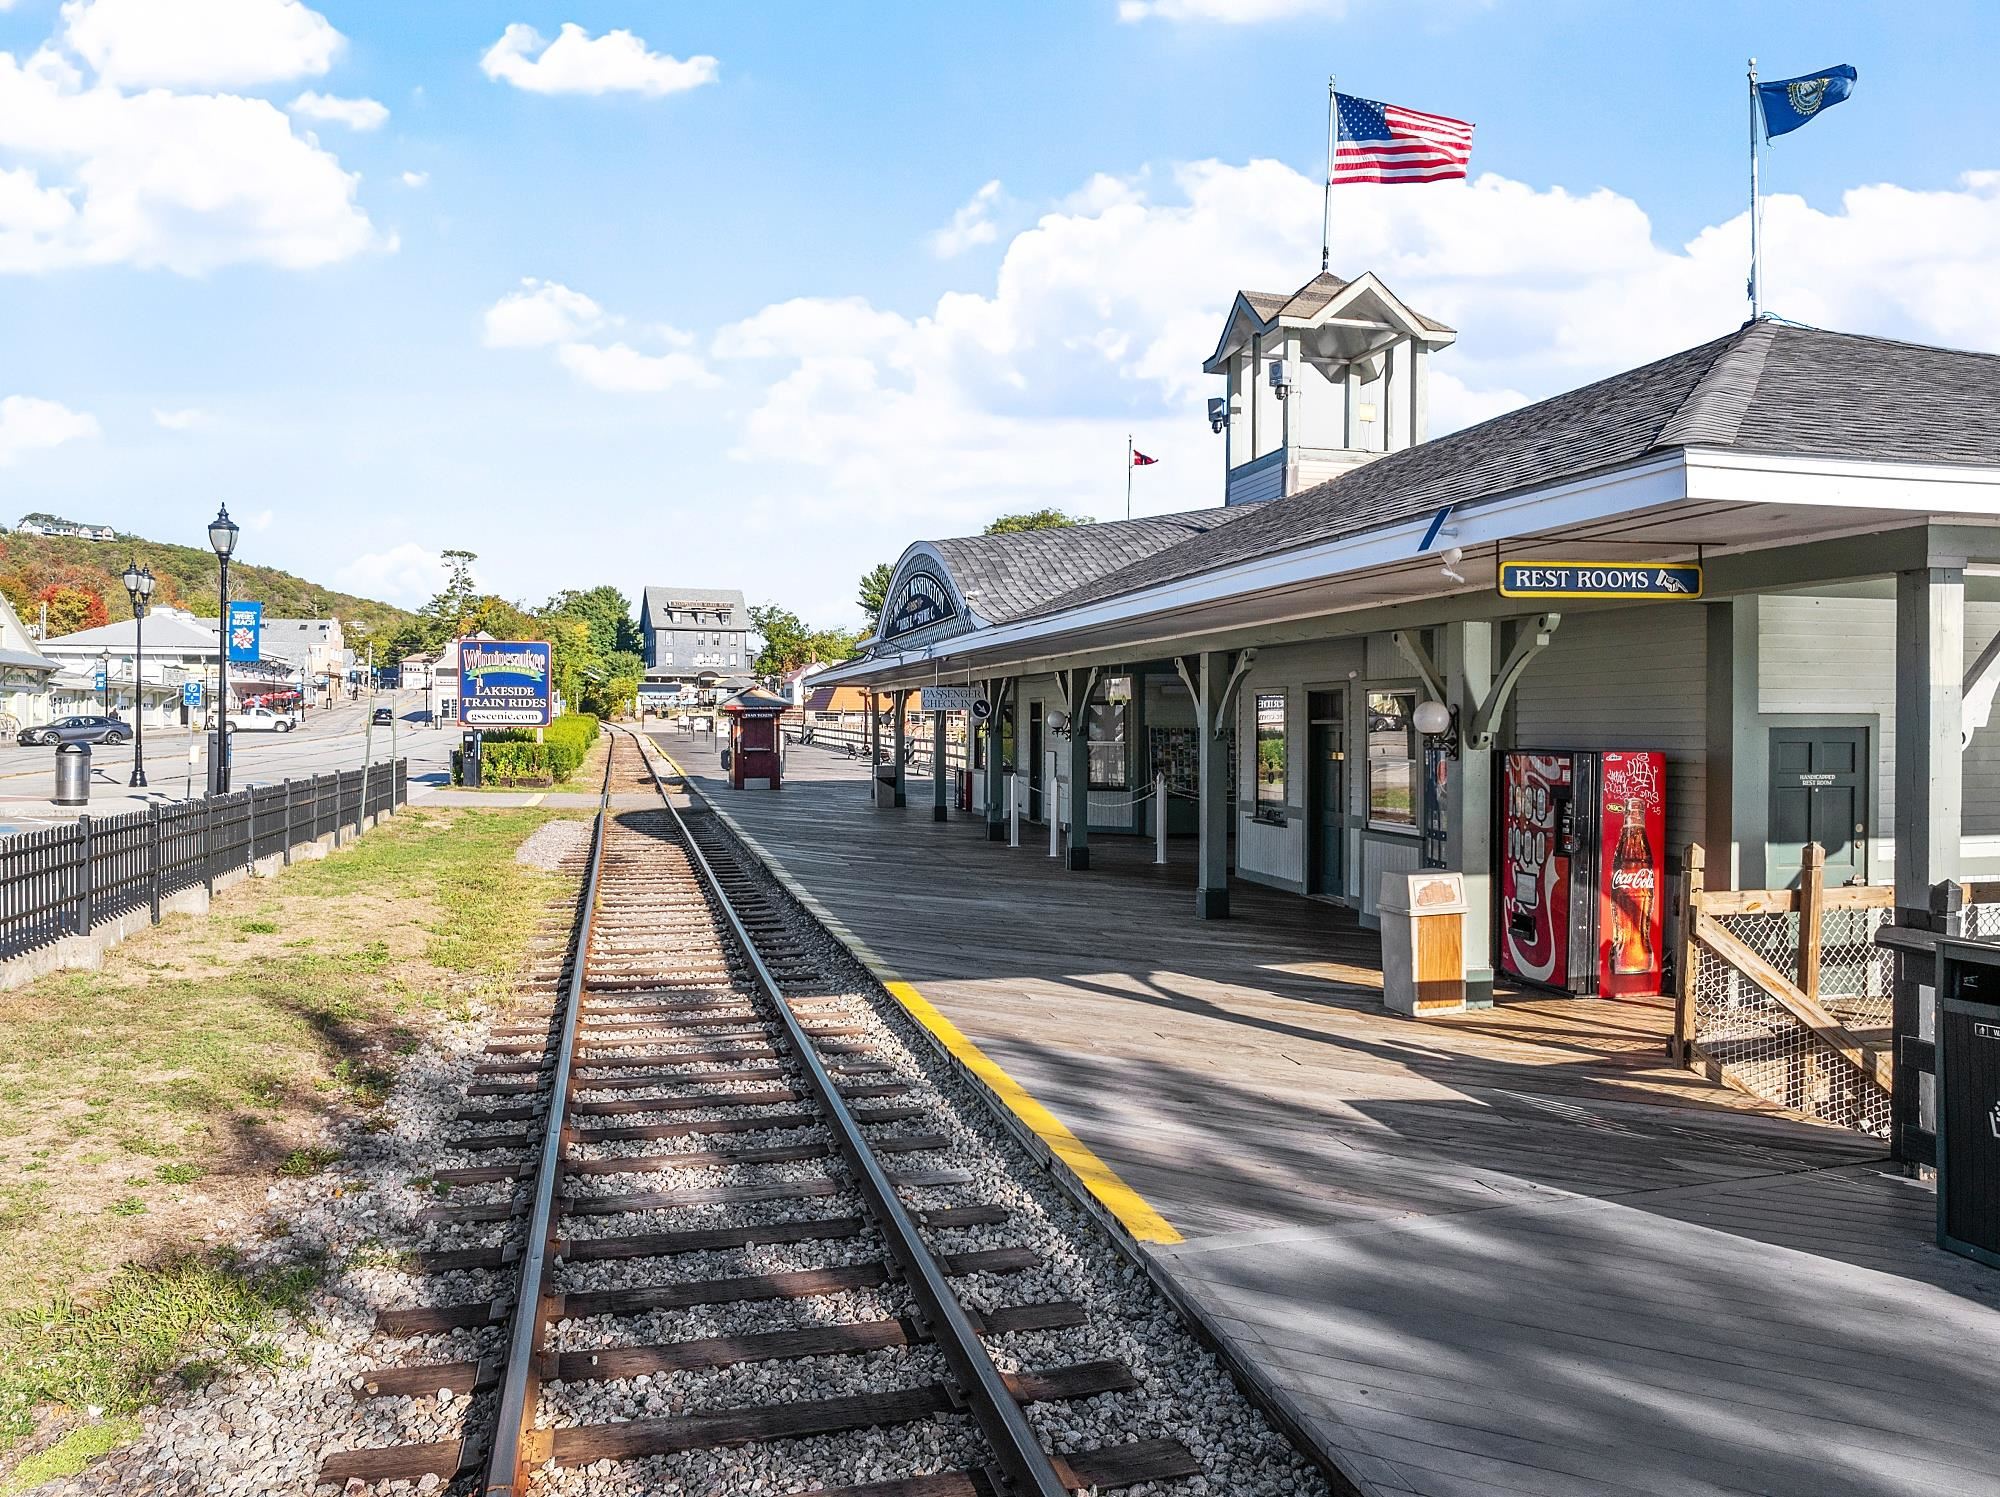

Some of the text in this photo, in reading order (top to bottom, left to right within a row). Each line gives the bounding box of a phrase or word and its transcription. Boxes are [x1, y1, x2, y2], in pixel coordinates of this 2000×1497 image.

[1515, 569, 1649, 588] REST ROOMS
[463, 646, 546, 673] Winnipesaukee
[475, 665, 535, 675] SCENIC RAILROAD
[475, 686, 535, 696] LAKESIDE
[923, 689, 981, 699] PASSENGER
[462, 697, 547, 708] TRAIN RIDES
[923, 699, 971, 708] CHECK-IN
[471, 711, 538, 721] gsscenic.com
